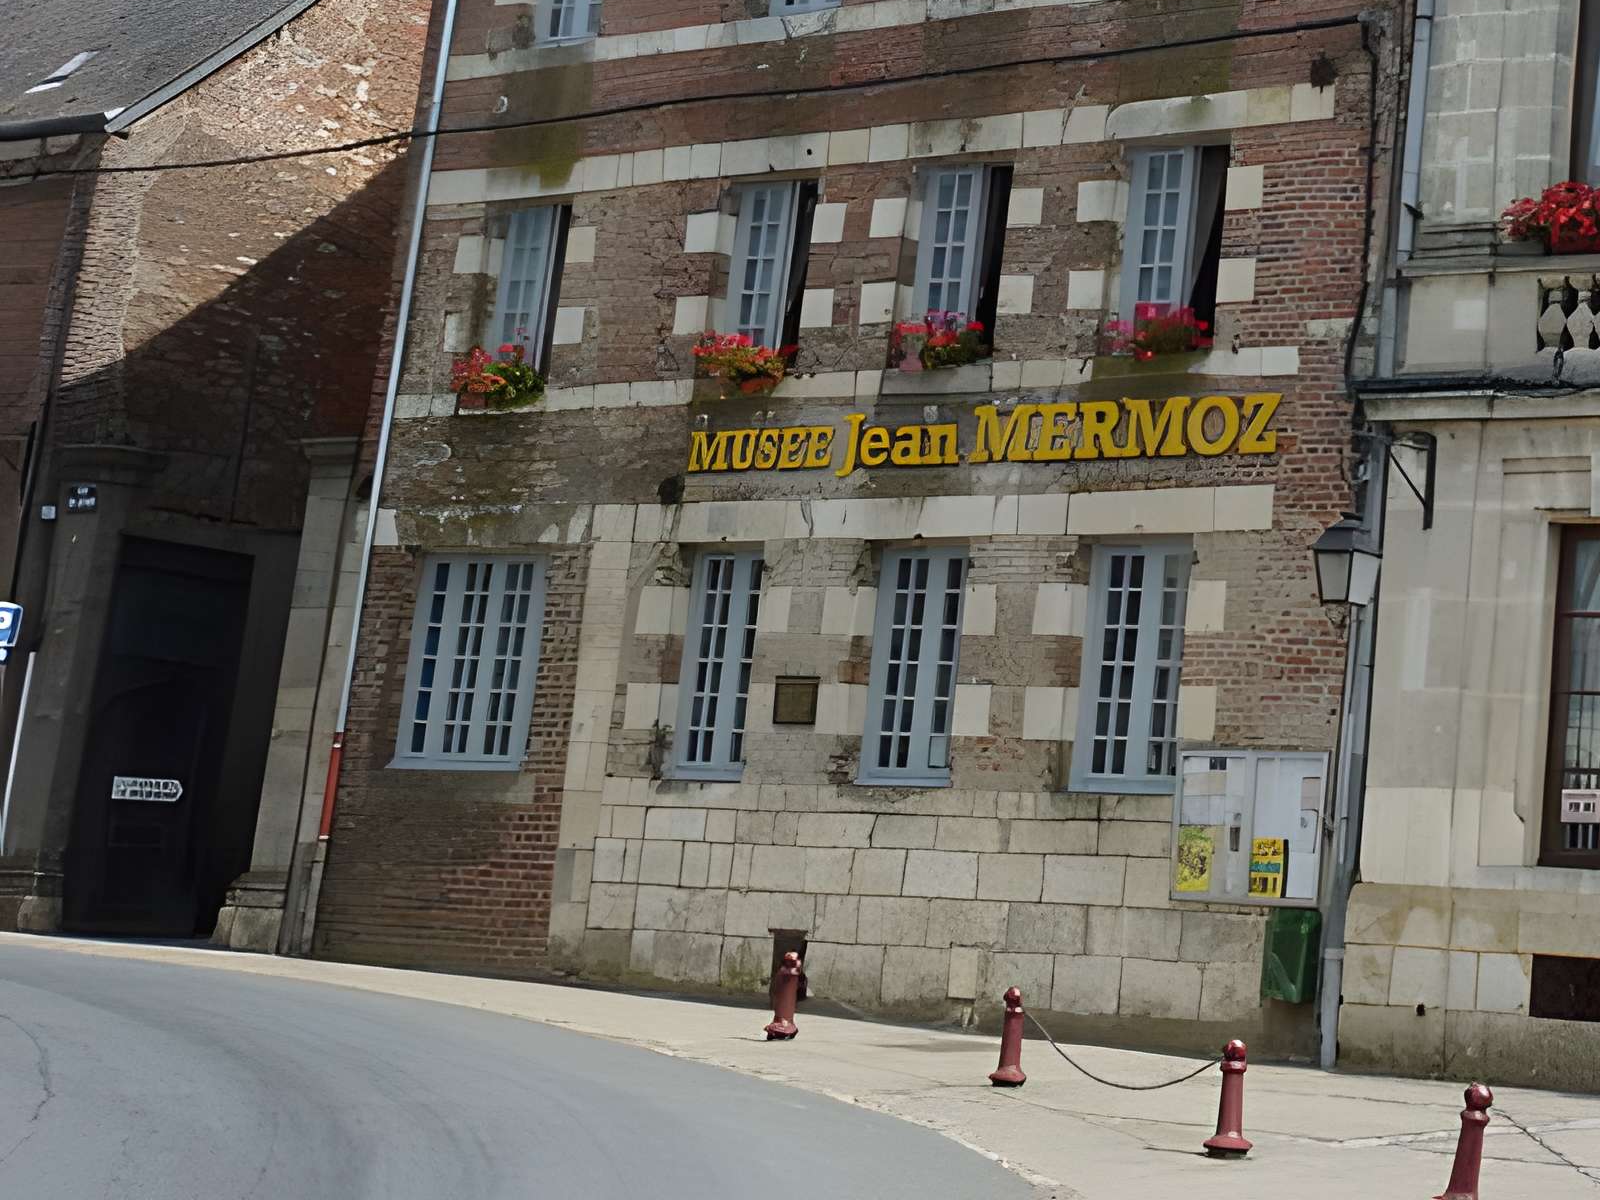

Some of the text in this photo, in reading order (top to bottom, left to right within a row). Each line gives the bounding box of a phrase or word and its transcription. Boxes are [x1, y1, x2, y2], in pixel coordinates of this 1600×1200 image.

[687, 392, 1283, 478] MUSEE Jean MERMOZ
